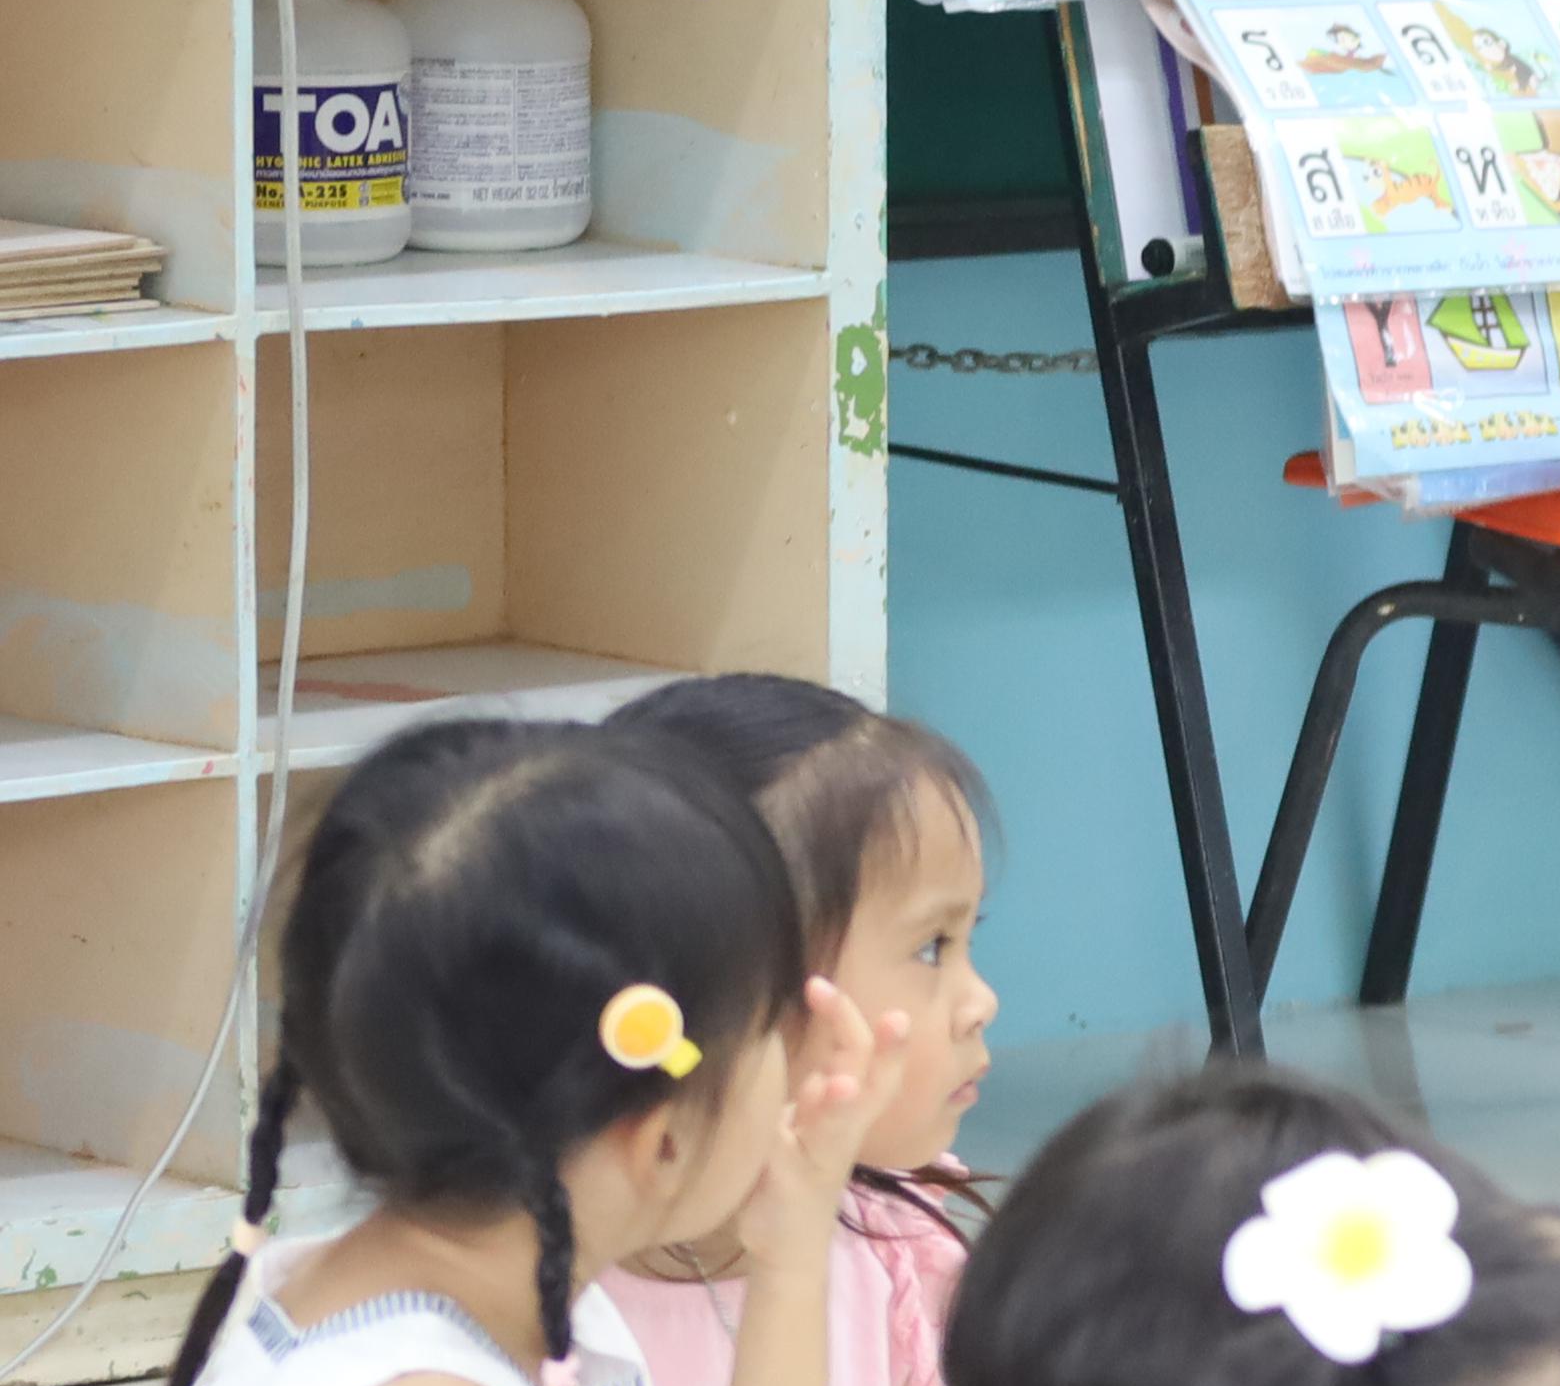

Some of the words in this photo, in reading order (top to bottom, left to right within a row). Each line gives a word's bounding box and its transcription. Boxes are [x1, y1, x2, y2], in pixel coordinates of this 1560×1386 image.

[1240, 28, 1285, 73] ร
[263, 89, 403, 154] TOA
[256, 155, 322, 169] HYGNIC
[1297, 146, 1346, 205] ส
[1454, 143, 1508, 197] ห
